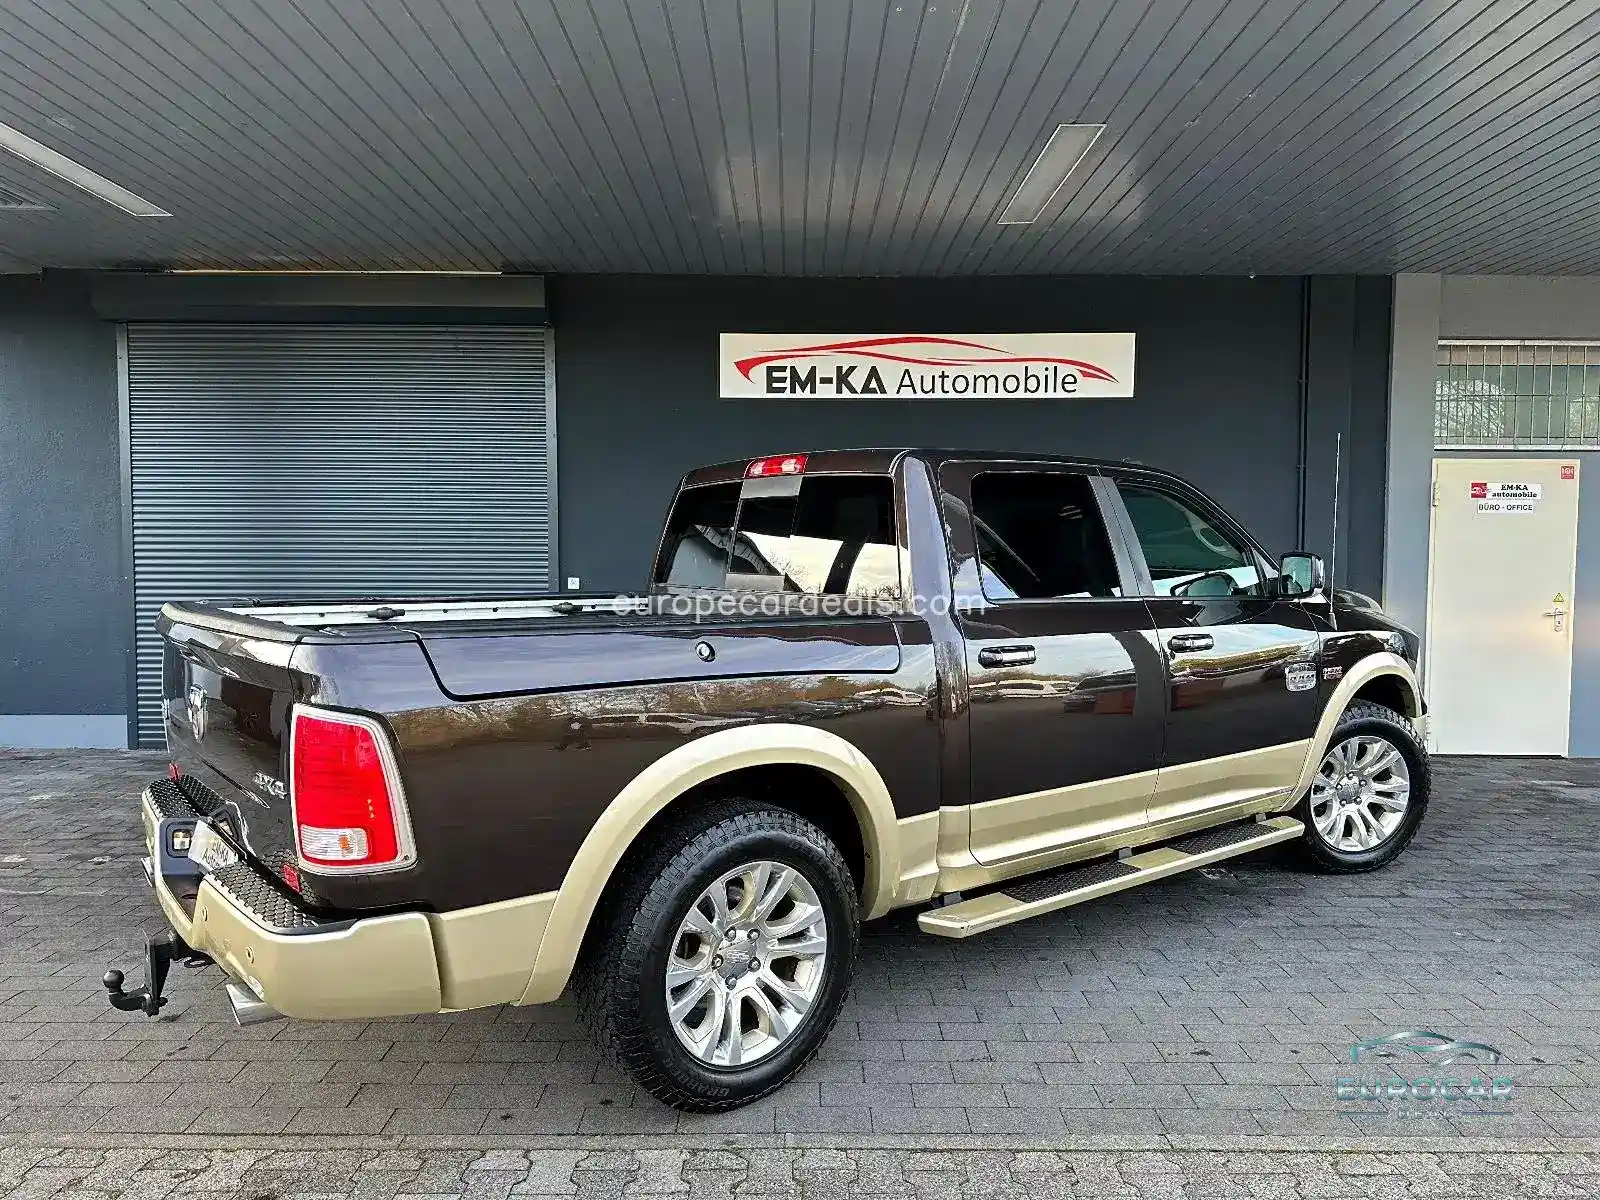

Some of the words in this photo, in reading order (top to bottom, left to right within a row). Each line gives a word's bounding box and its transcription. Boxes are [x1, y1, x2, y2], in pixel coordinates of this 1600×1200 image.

[765, 365, 887, 395] EM-KA
[895, 366, 1079, 396] Automobile
[1478, 502, 1500, 510] BÜRO
[1506, 503, 1533, 511] OFFICE
